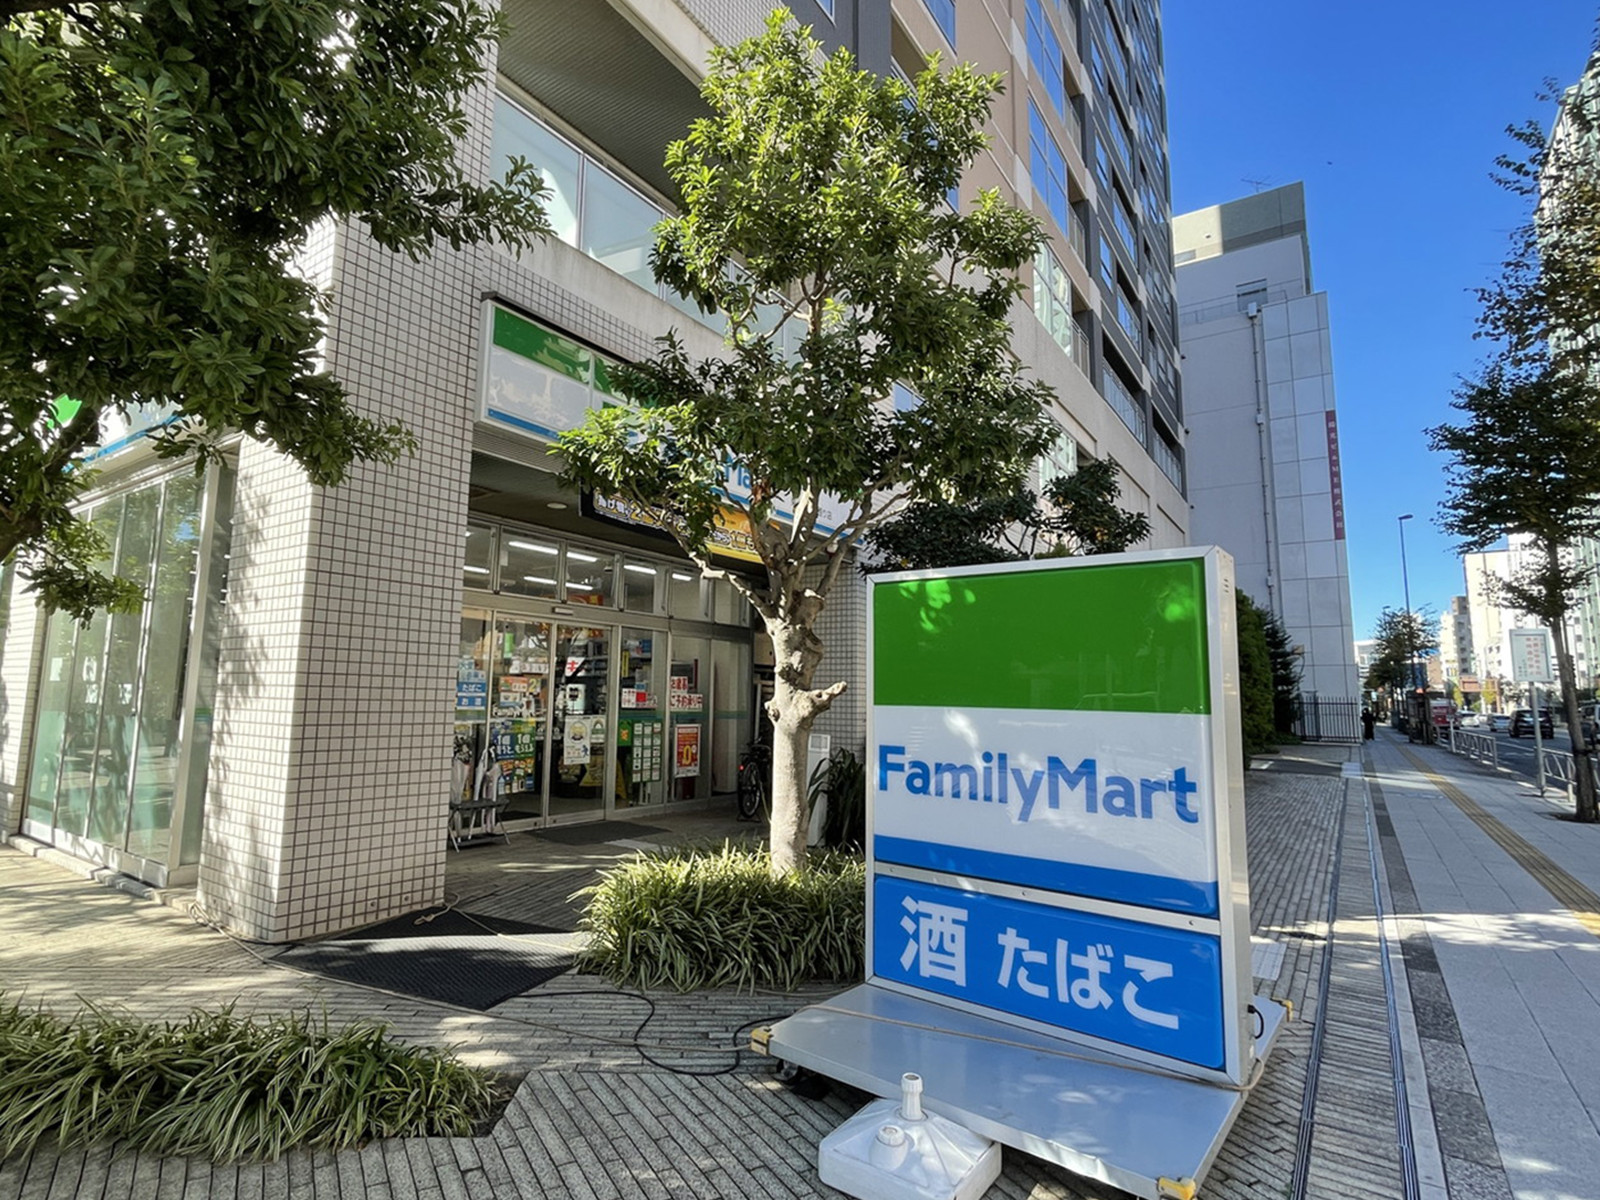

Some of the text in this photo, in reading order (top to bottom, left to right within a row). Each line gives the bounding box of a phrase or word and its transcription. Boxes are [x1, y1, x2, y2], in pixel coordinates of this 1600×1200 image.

[462, 683, 483, 693] たばこ
[878, 744, 1199, 824] FamilyMart
[900, 894, 1180, 1030] 酒 たばこ
